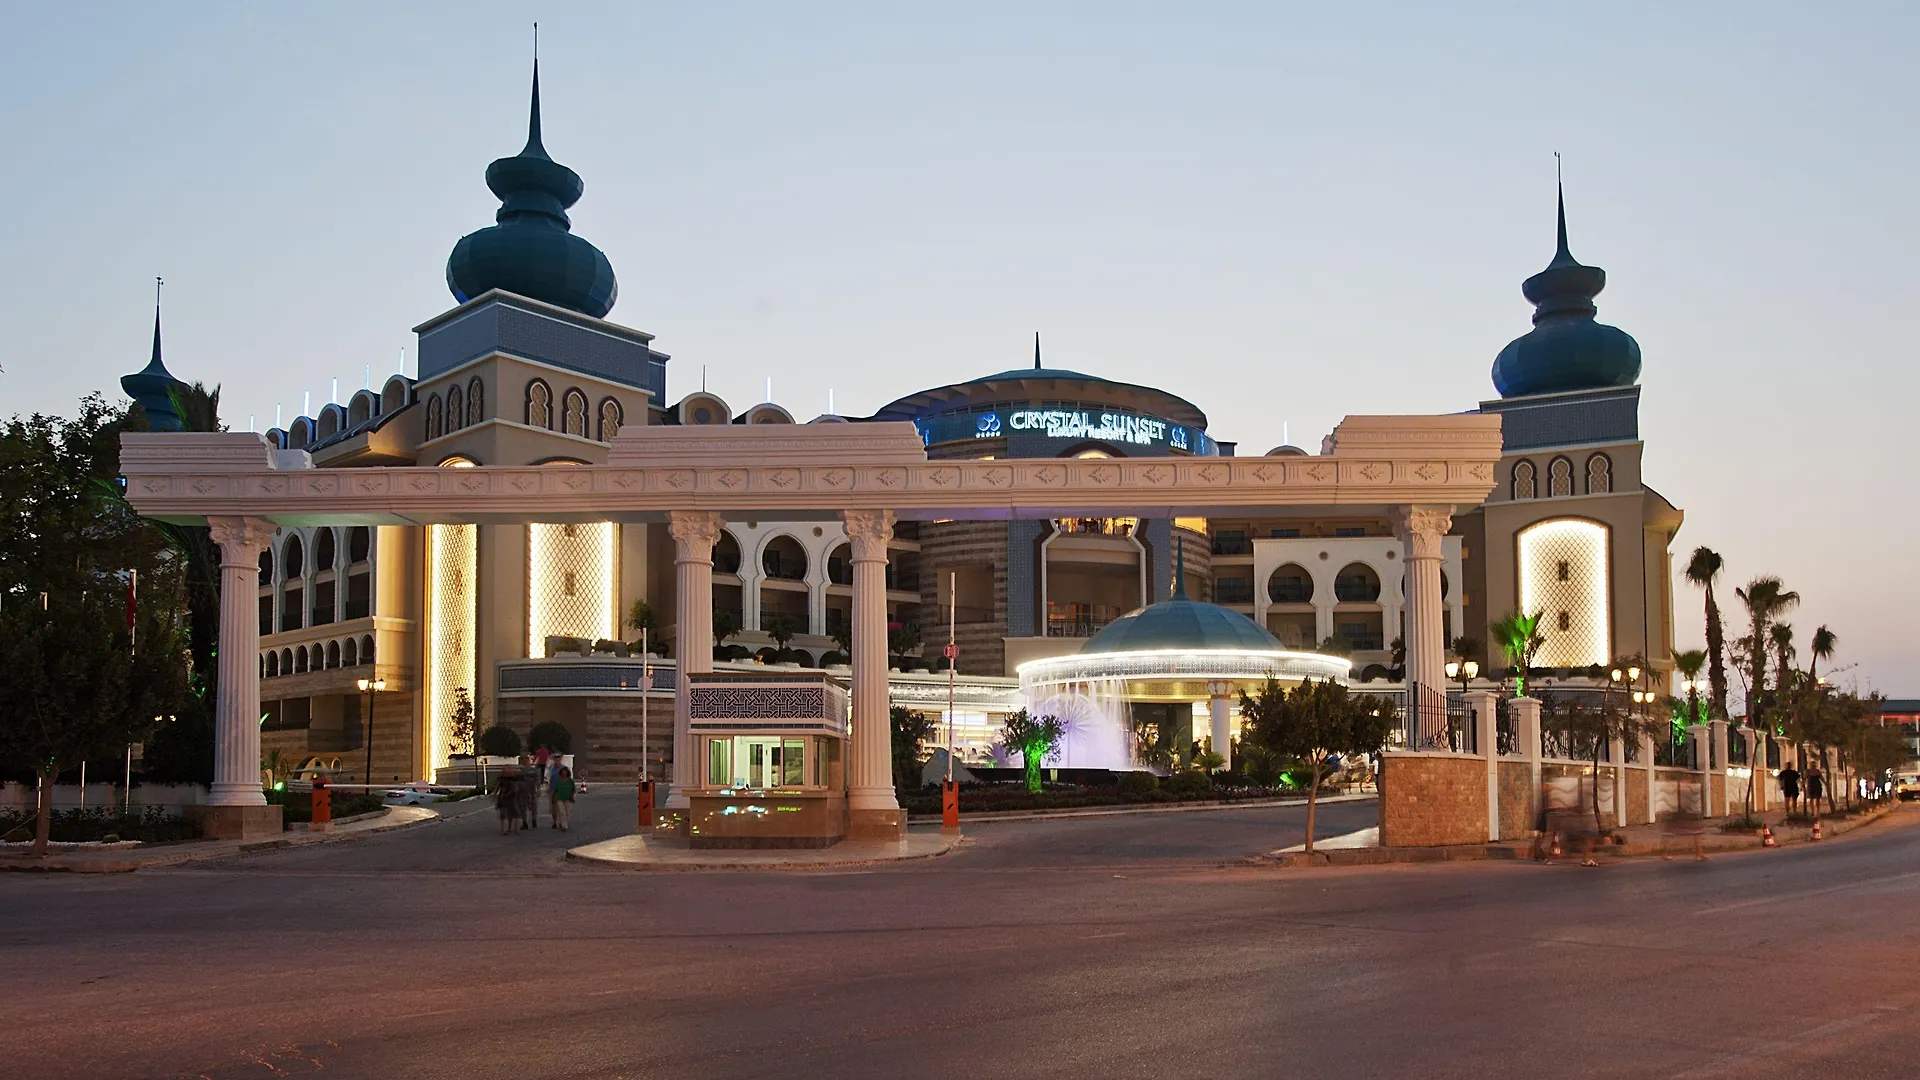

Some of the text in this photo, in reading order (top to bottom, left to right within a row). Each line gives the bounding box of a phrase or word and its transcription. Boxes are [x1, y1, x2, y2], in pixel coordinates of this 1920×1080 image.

[1010, 411, 1166, 439] CRYSTAL SUNSET
[1047, 426, 1086, 437] LUXURY
[1088, 427, 1125, 441] RESORT
